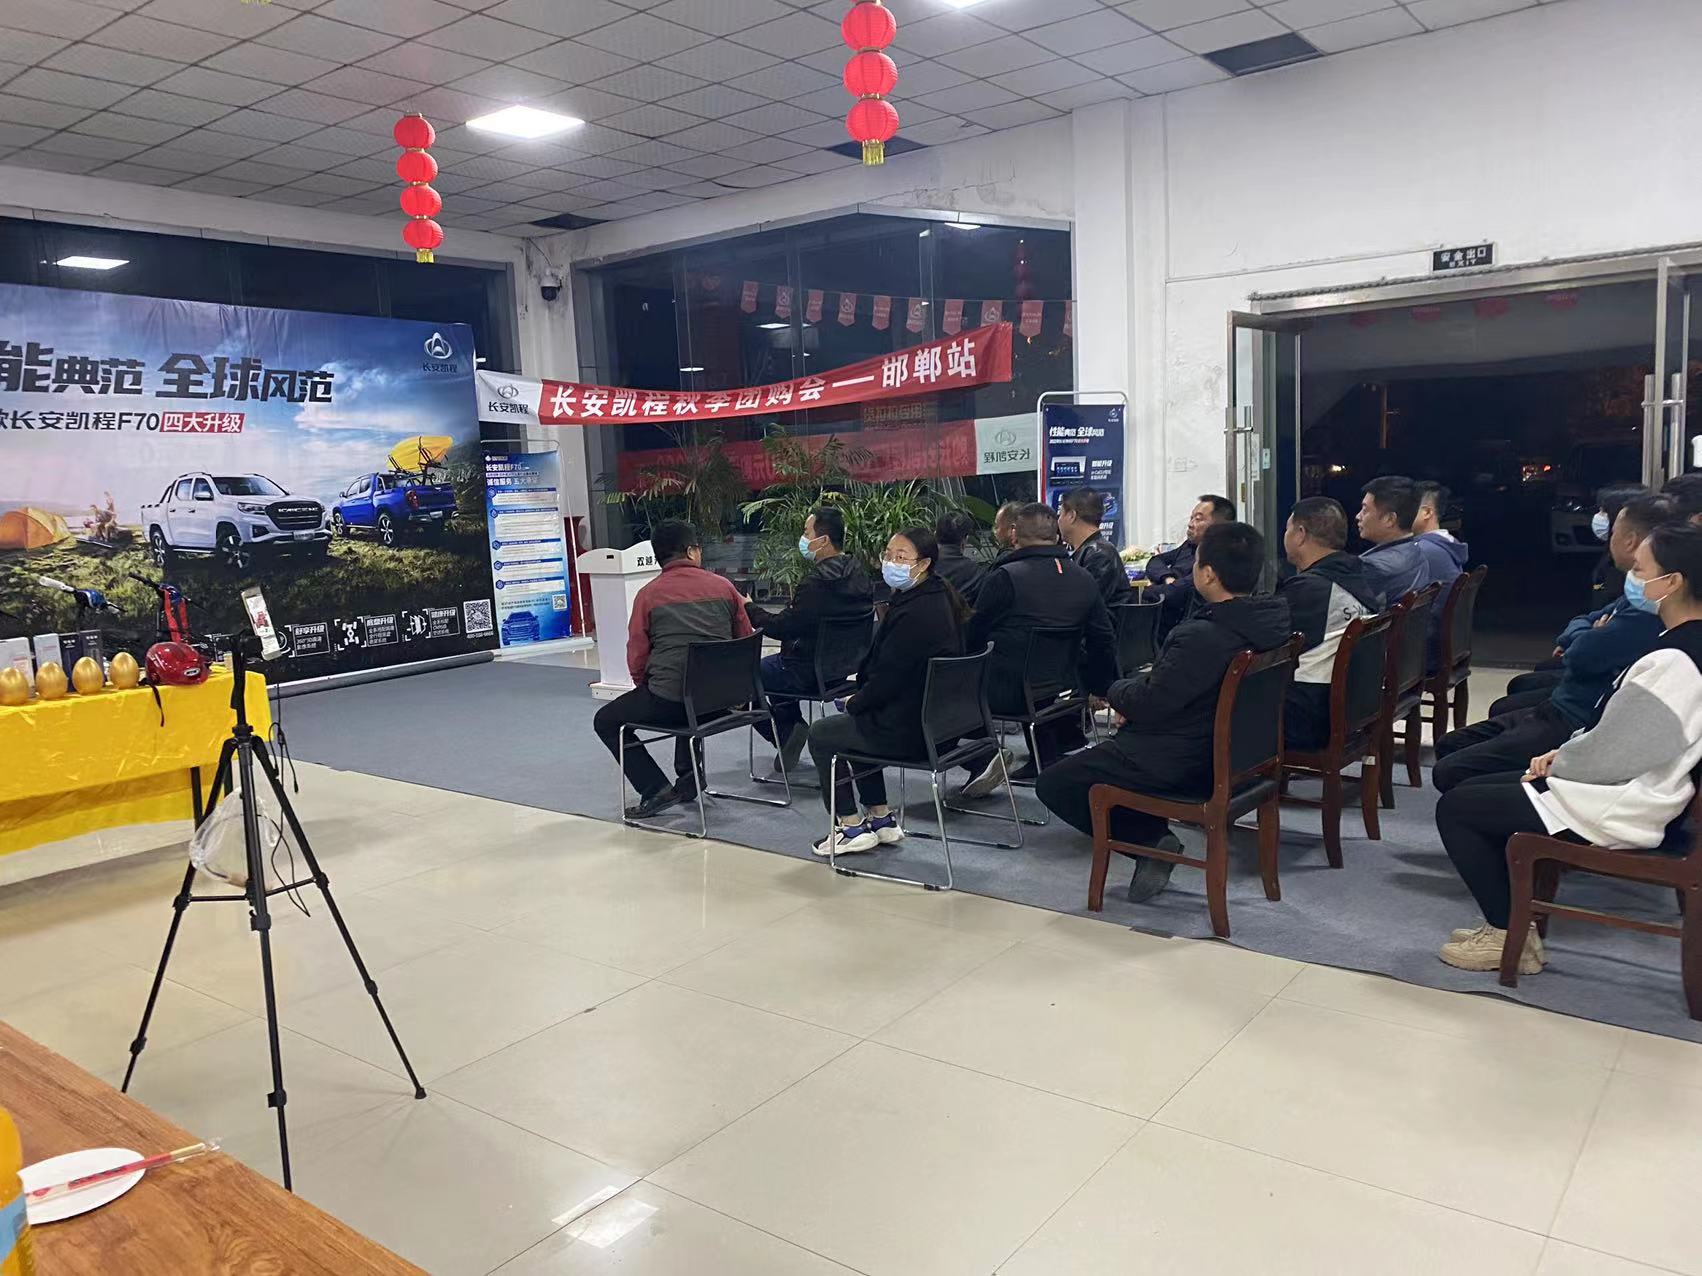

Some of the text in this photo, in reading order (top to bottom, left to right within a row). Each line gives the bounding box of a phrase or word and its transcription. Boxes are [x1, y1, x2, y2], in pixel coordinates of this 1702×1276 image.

[1441, 247, 1487, 262] 安全出口
[422, 362, 458, 373] 长安凯程
[155, 352, 335, 403] 全球风范
[488, 401, 529, 415] 长安凯程
[163, 412, 242, 433] 四大升级
[636, 556, 657, 567] 欢迎
